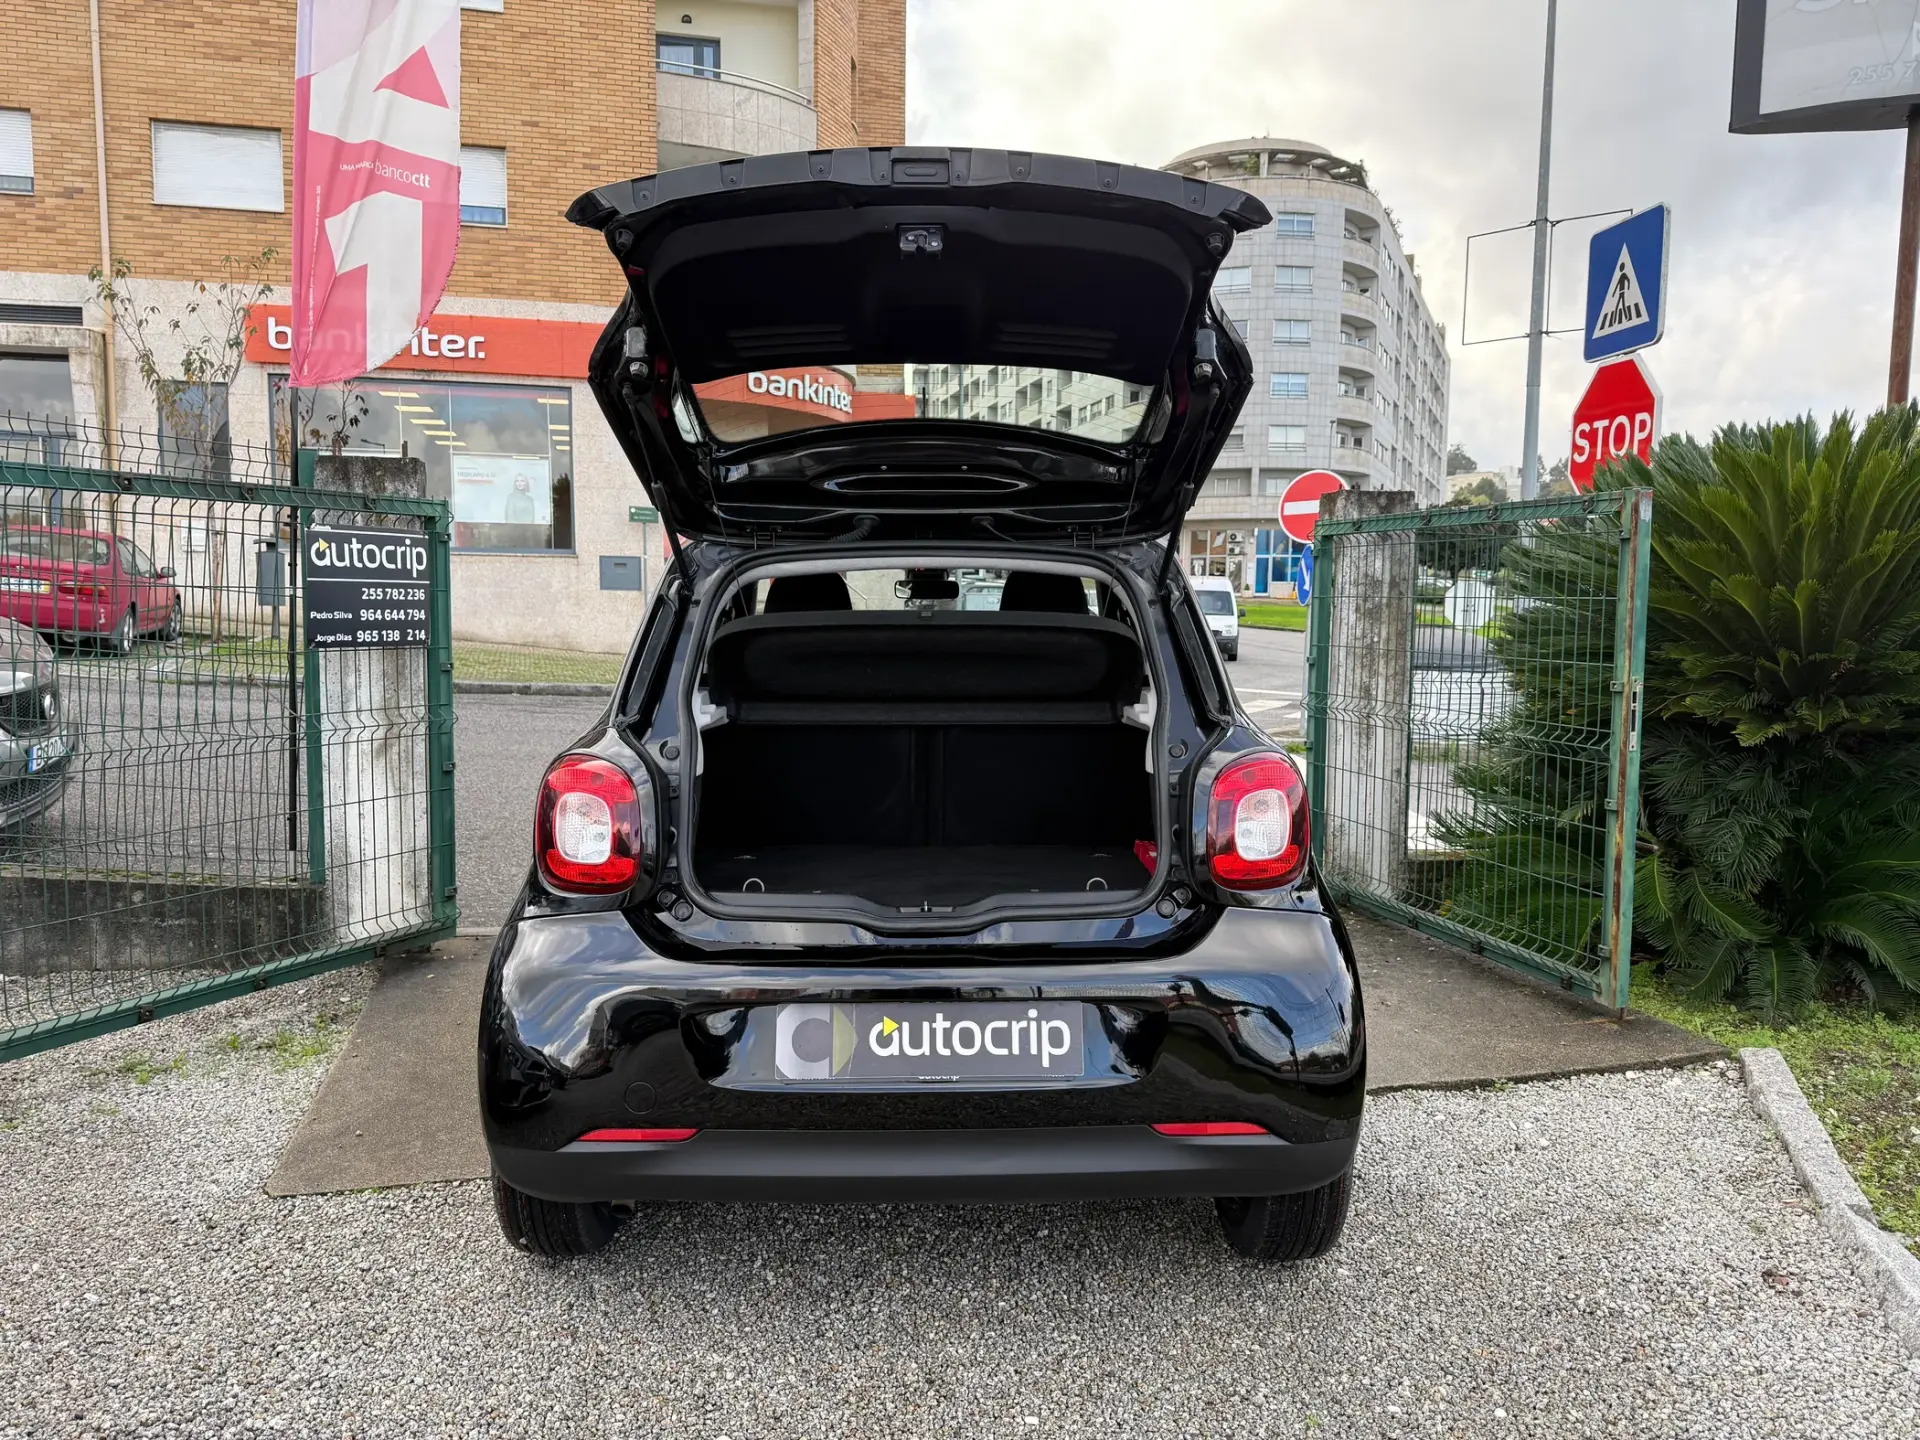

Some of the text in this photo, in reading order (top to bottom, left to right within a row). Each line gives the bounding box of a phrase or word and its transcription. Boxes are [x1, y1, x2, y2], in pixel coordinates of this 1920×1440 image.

[339, 163, 355, 171] UMA
[1573, 412, 1652, 463] STOP
[310, 537, 427, 578] autocrip
[361, 588, 426, 601] 255 782 236
[310, 609, 426, 621] Pedro Silva 964 644 794
[314, 629, 426, 643] Jorge Dias 965 138 214
[869, 1008, 1072, 1068] autocrip
